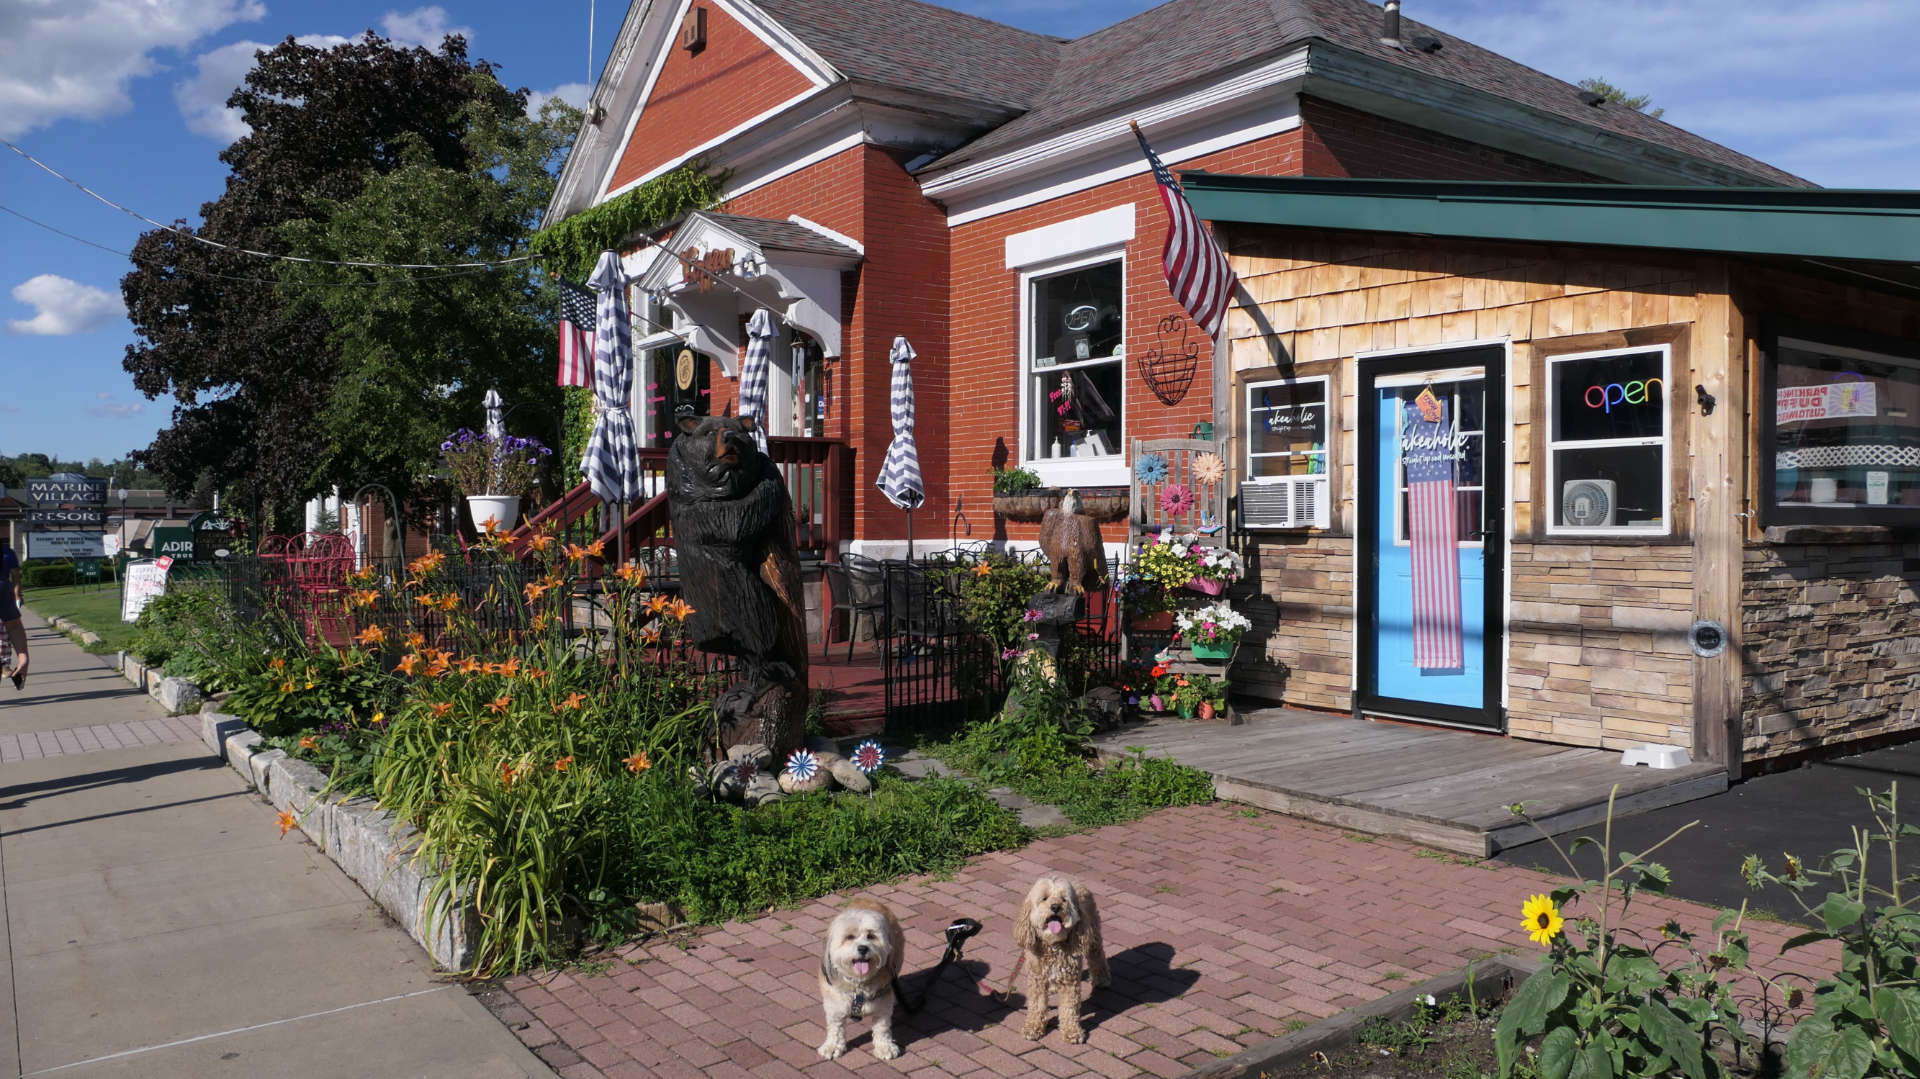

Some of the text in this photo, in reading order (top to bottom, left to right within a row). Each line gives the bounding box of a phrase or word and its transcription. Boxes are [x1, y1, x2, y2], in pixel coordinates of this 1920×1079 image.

[1585, 378, 1664, 413] open
[31, 482, 102, 491] MARINE
[31, 492, 104, 501] VILLAGE
[31, 512, 103, 521] RESORT
